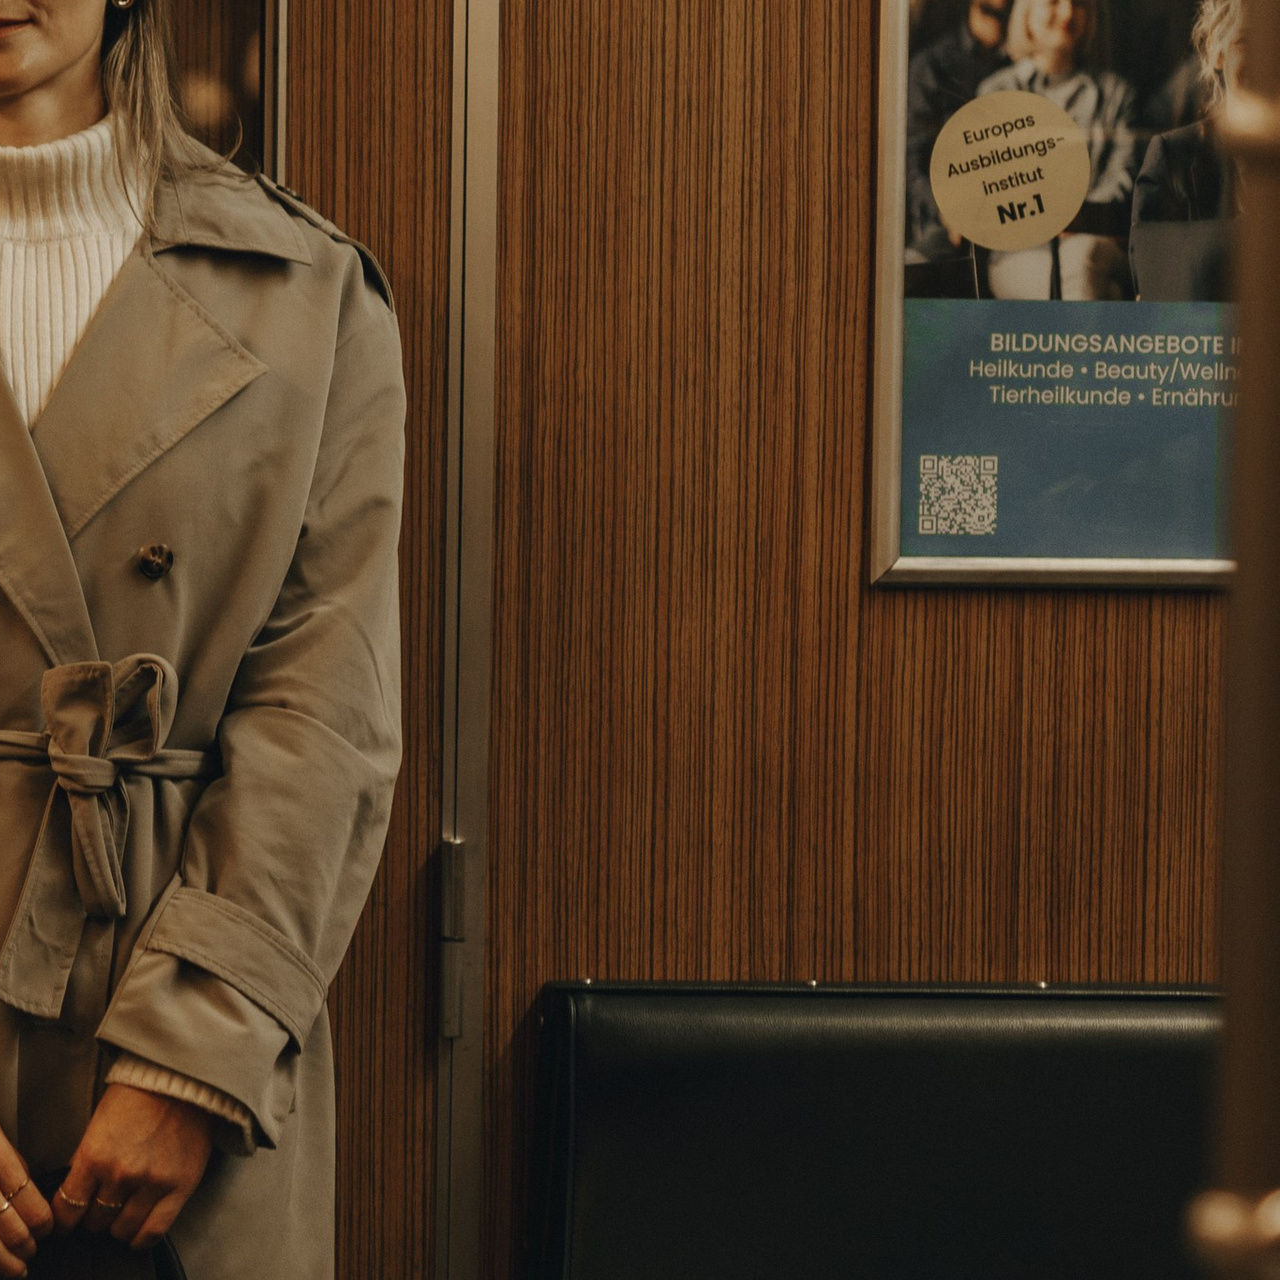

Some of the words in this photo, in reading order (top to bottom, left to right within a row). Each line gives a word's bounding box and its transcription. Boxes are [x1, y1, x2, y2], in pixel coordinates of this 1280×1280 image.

[963, 114, 1036, 145] Europas
[947, 136, 1065, 178] Ausbildungs-
[982, 166, 1045, 196] institut
[996, 193, 1045, 225] Nr.1
[990, 333, 1224, 355] BILDUNGSANGEBOTE
[969, 359, 1074, 379] Heilkunde
[1094, 357, 1239, 385] Beauty/Welln
[989, 385, 1132, 406] Tierheilkunde
